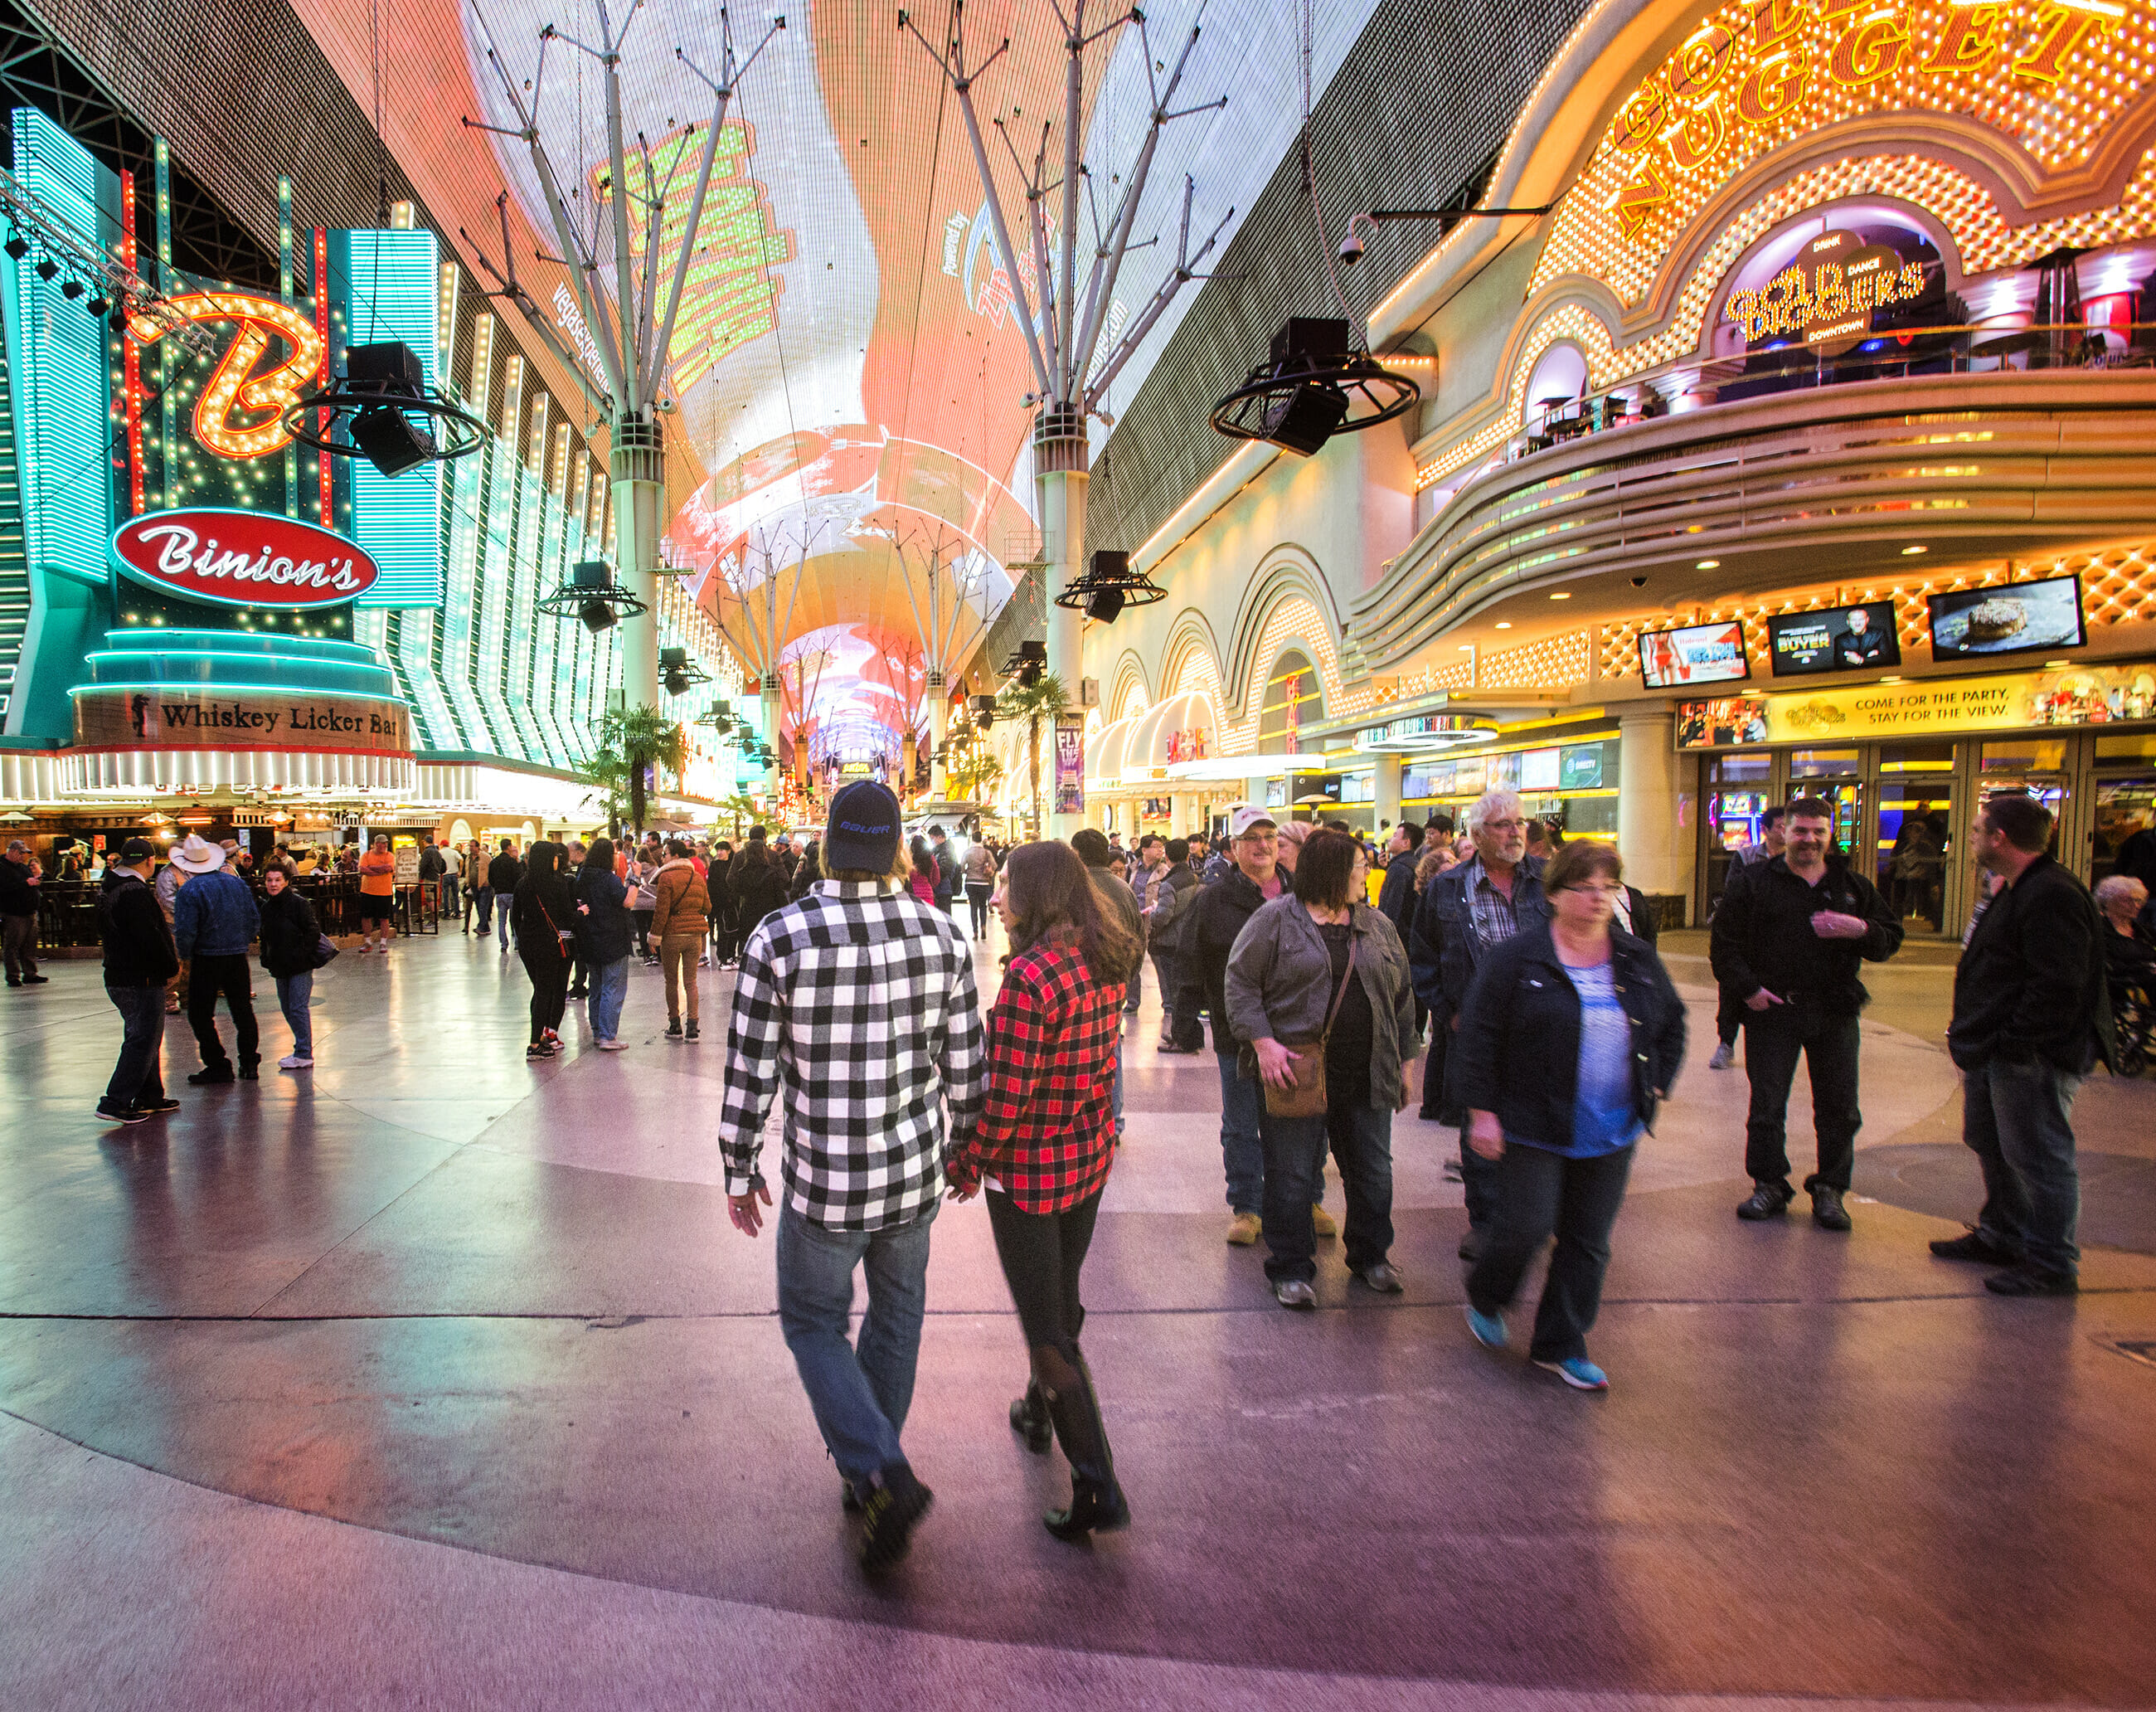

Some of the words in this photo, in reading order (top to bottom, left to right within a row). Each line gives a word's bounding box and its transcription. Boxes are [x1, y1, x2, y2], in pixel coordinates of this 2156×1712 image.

[1611, 0, 1877, 153] GOL
[1604, 0, 2123, 241] NUGGET
[948, 211, 971, 231] by
[942, 224, 962, 278] Powered
[1813, 233, 1842, 253] DRINK
[1848, 255, 1882, 276] DANCE
[1726, 262, 1843, 322] GOLD
[1745, 261, 1925, 343] DIGGERS
[1809, 318, 1866, 343] DOWNTOWN
[125, 292, 323, 460] B
[138, 524, 360, 591] Binion's
[1778, 635, 1830, 653] BUYER
[1856, 698, 1895, 711] COME
[1900, 695, 1927, 708] FOR
[1932, 693, 1957, 704] THE
[1963, 688, 2009, 703] PARTY,
[1869, 713, 1899, 724] STAY
[1904, 710, 1931, 722] FOR
[1937, 708, 1961, 720] THE
[1967, 704, 2008, 717] VIEW.
[161, 703, 281, 733] Whiskey
[290, 708, 363, 732] Licker
[370, 713, 396, 736] Bar
[1056, 732, 1083, 750] FLY
